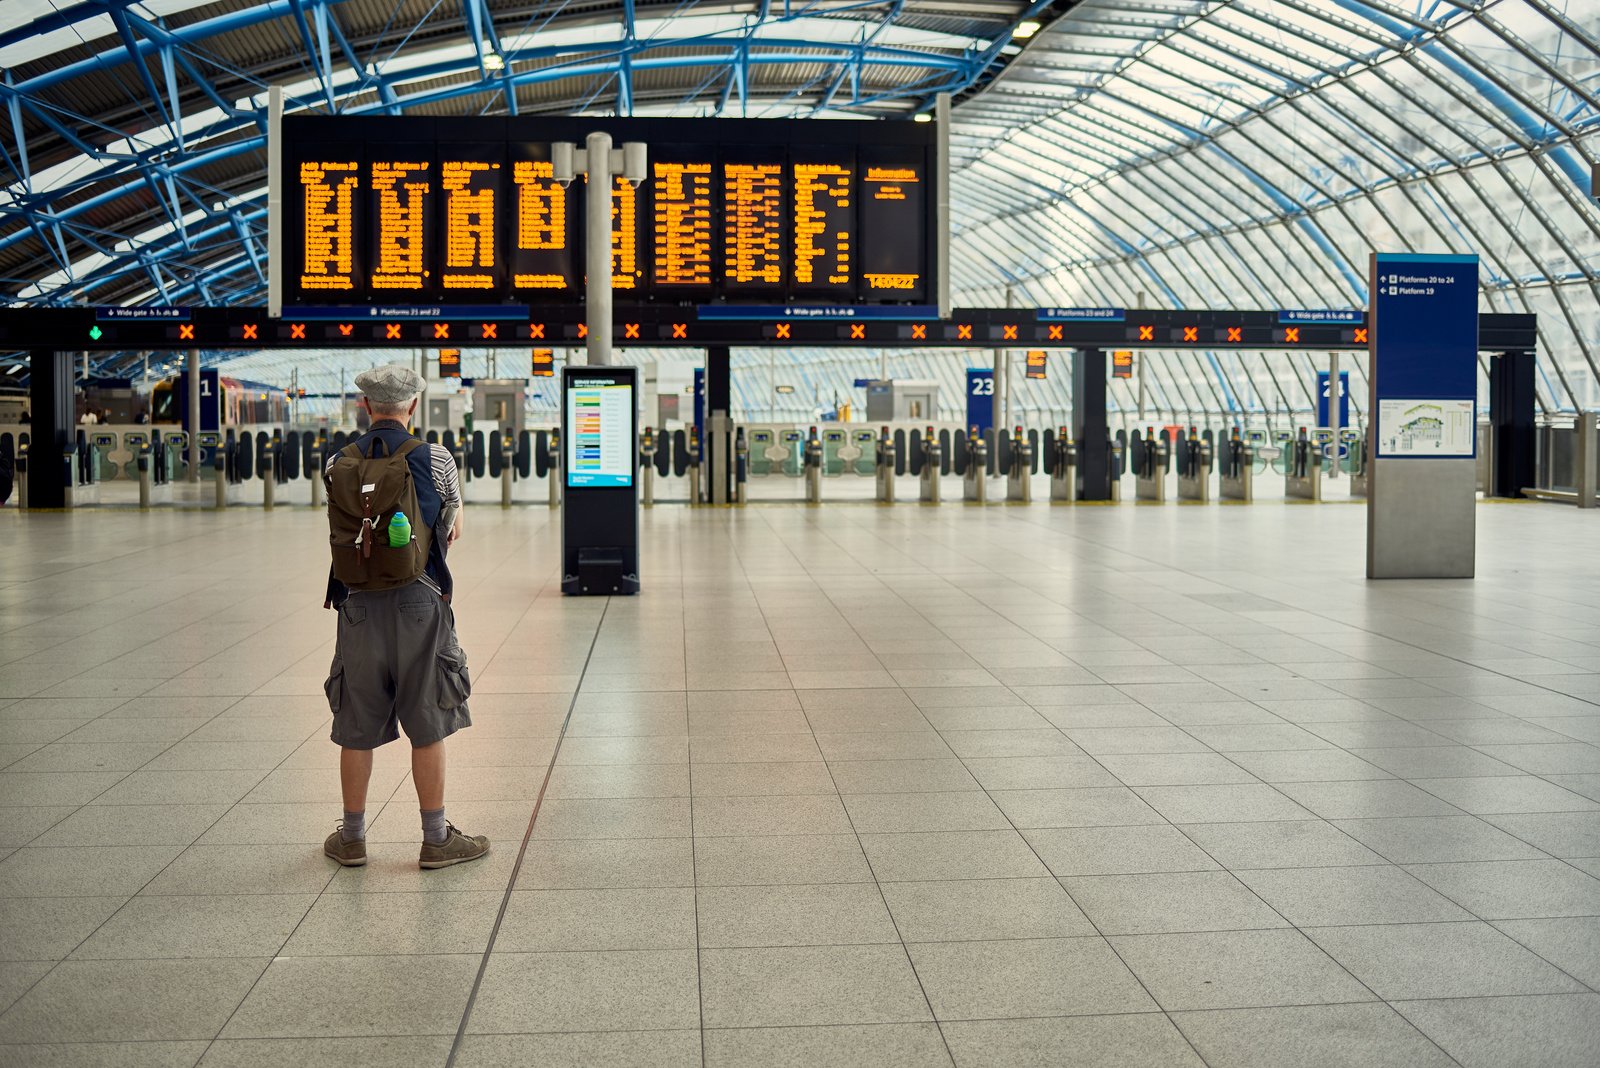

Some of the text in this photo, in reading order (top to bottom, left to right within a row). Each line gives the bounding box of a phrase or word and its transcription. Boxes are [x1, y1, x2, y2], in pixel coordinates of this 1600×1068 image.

[1399, 276, 1428, 284] Platforms
[1429, 276, 1437, 284] 20
[1446, 276, 1454, 284] 24
[1399, 286, 1434, 295] Platform 19
[380, 308, 409, 316] Platforms
[419, 308, 431, 316] and
[793, 308, 823, 317] Wide gate
[1057, 309, 1085, 317] Platforms
[972, 378, 994, 396] 23
